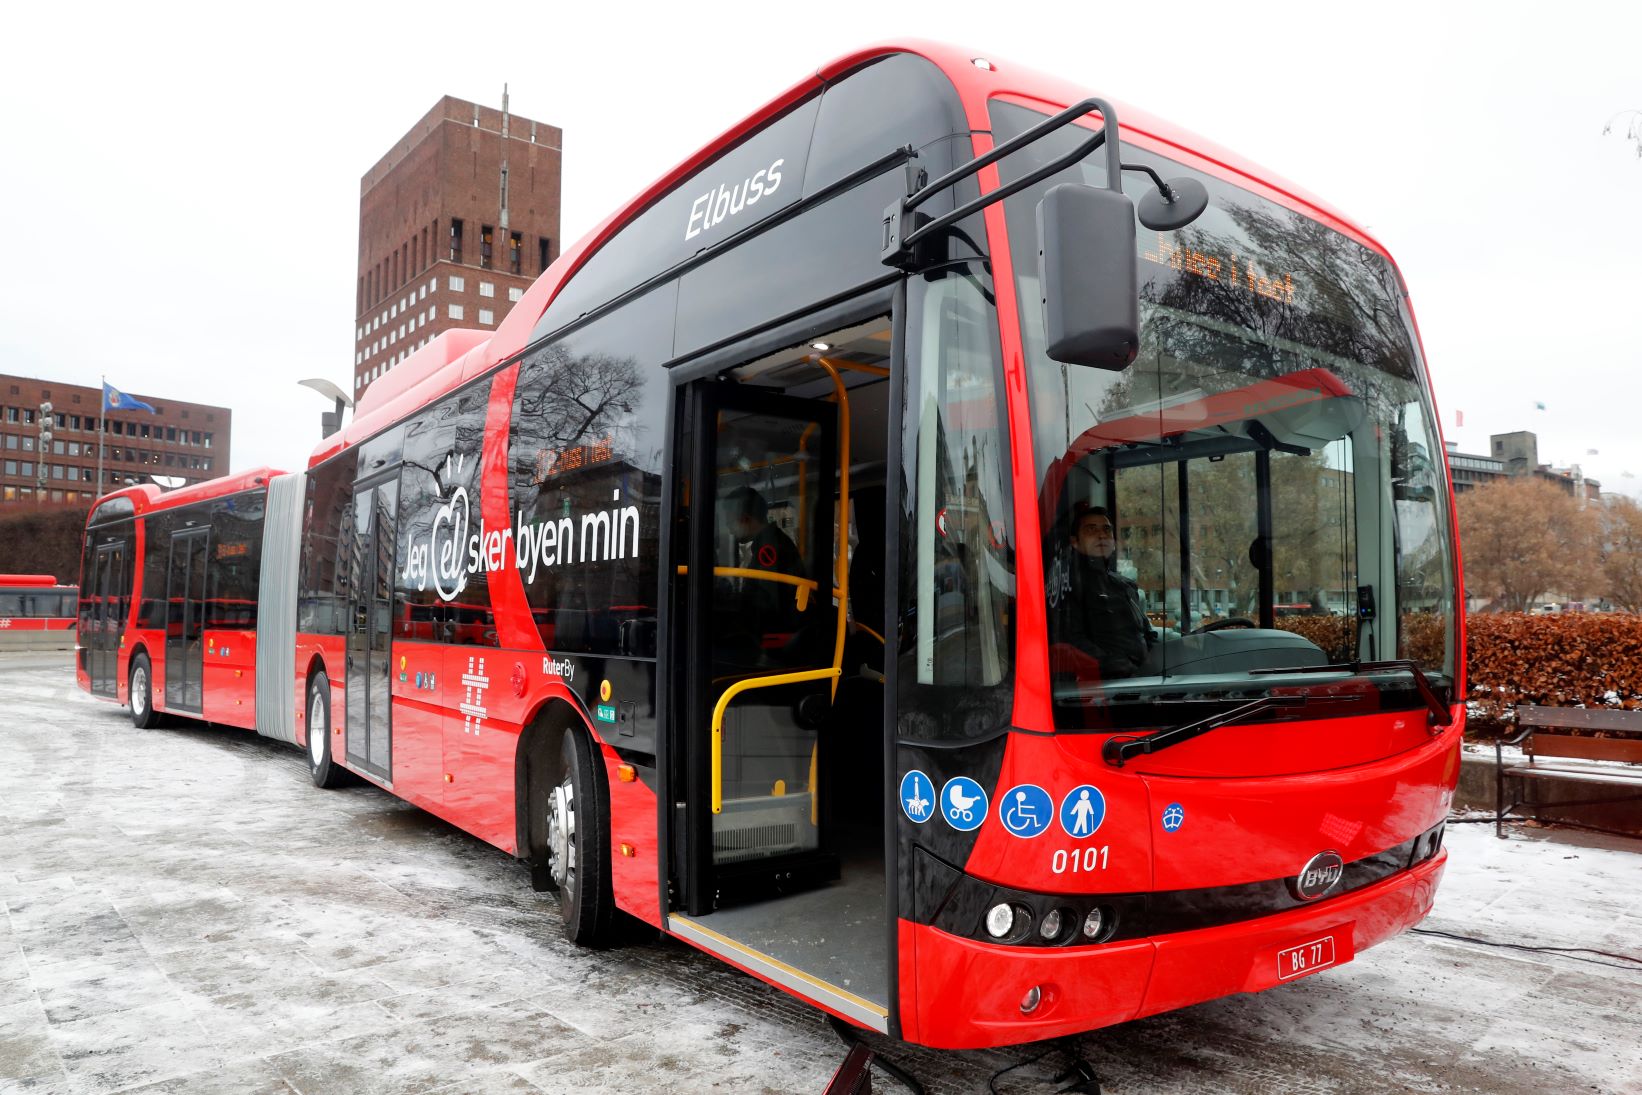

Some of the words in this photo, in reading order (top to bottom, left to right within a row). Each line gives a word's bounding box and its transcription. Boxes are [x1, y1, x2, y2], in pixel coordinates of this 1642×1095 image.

[685, 158, 784, 241] Elbuss
[402, 534, 428, 592] Jeg
[515, 510, 573, 585] byen
[580, 488, 640, 563] min
[543, 656, 575, 682] RuterBy
[1052, 845, 1109, 874] 0101
[1304, 865, 1339, 888] BYD
[1292, 949, 1306, 971] BG
[1311, 943, 1322, 965] 77
